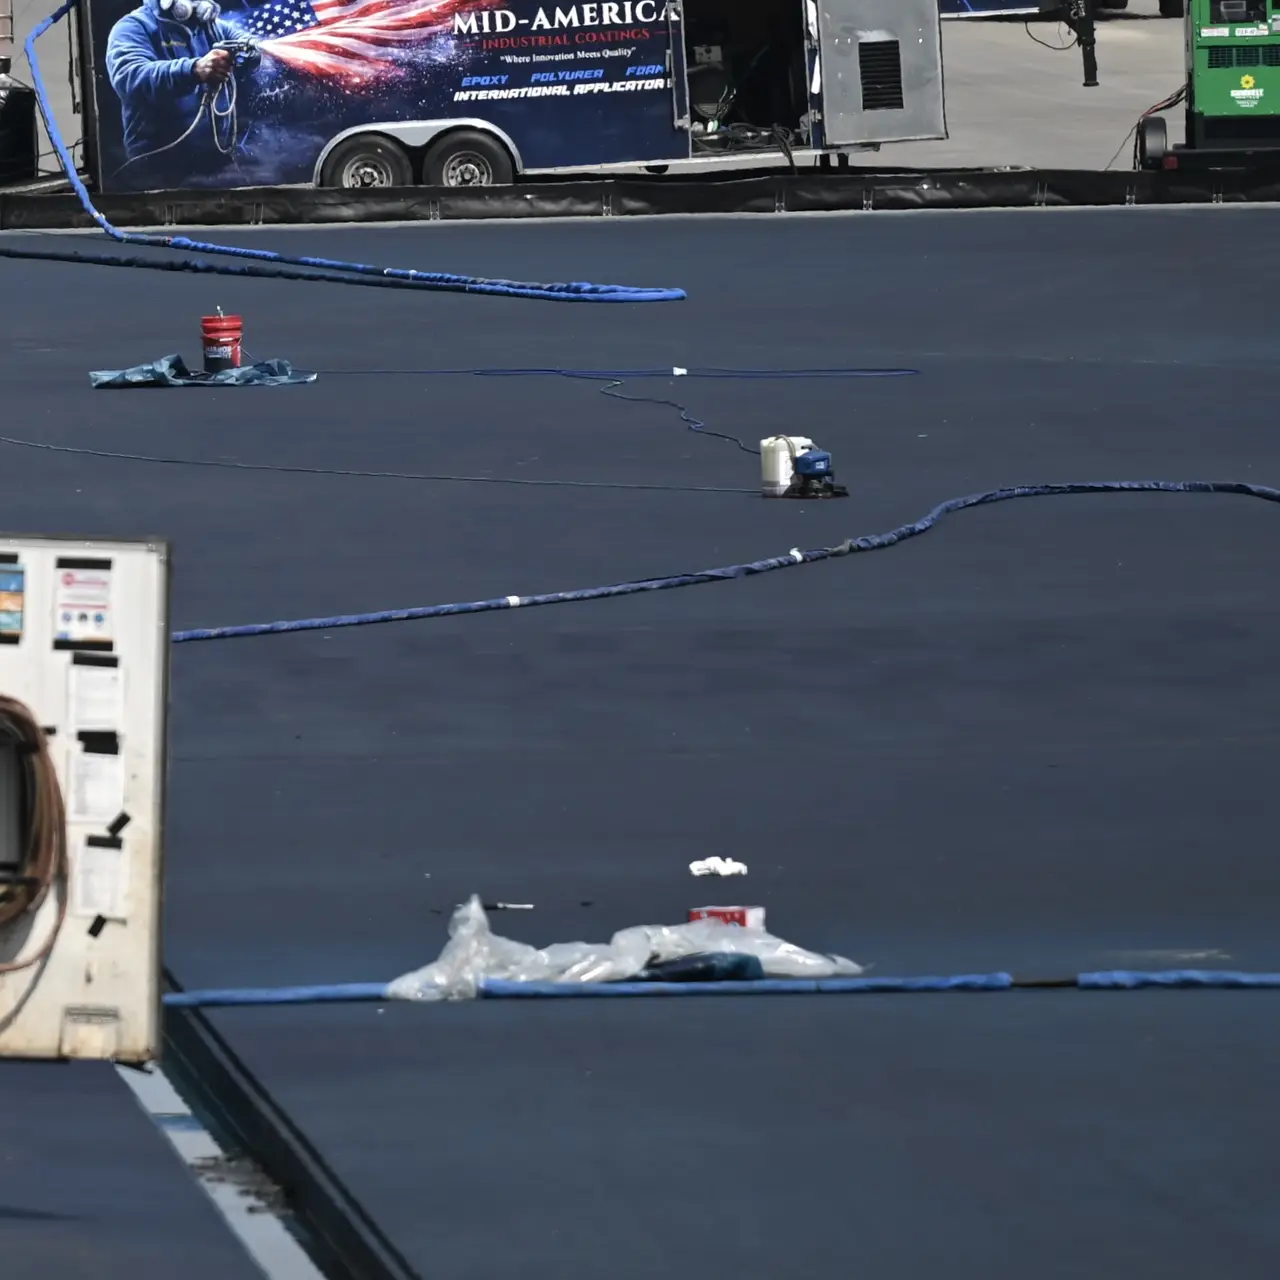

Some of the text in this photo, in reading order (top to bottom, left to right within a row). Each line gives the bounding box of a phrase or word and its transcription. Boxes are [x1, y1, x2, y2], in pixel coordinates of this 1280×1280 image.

[482, 27, 650, 50] INDUSTRIAL COATINGS
[532, 51, 575, 62] Innovation
[576, 49, 602, 59] Meets
[461, 74, 509, 87] EPOXY
[530, 68, 605, 83] POLYUREA
[453, 85, 571, 102] INTERNATIONAL
